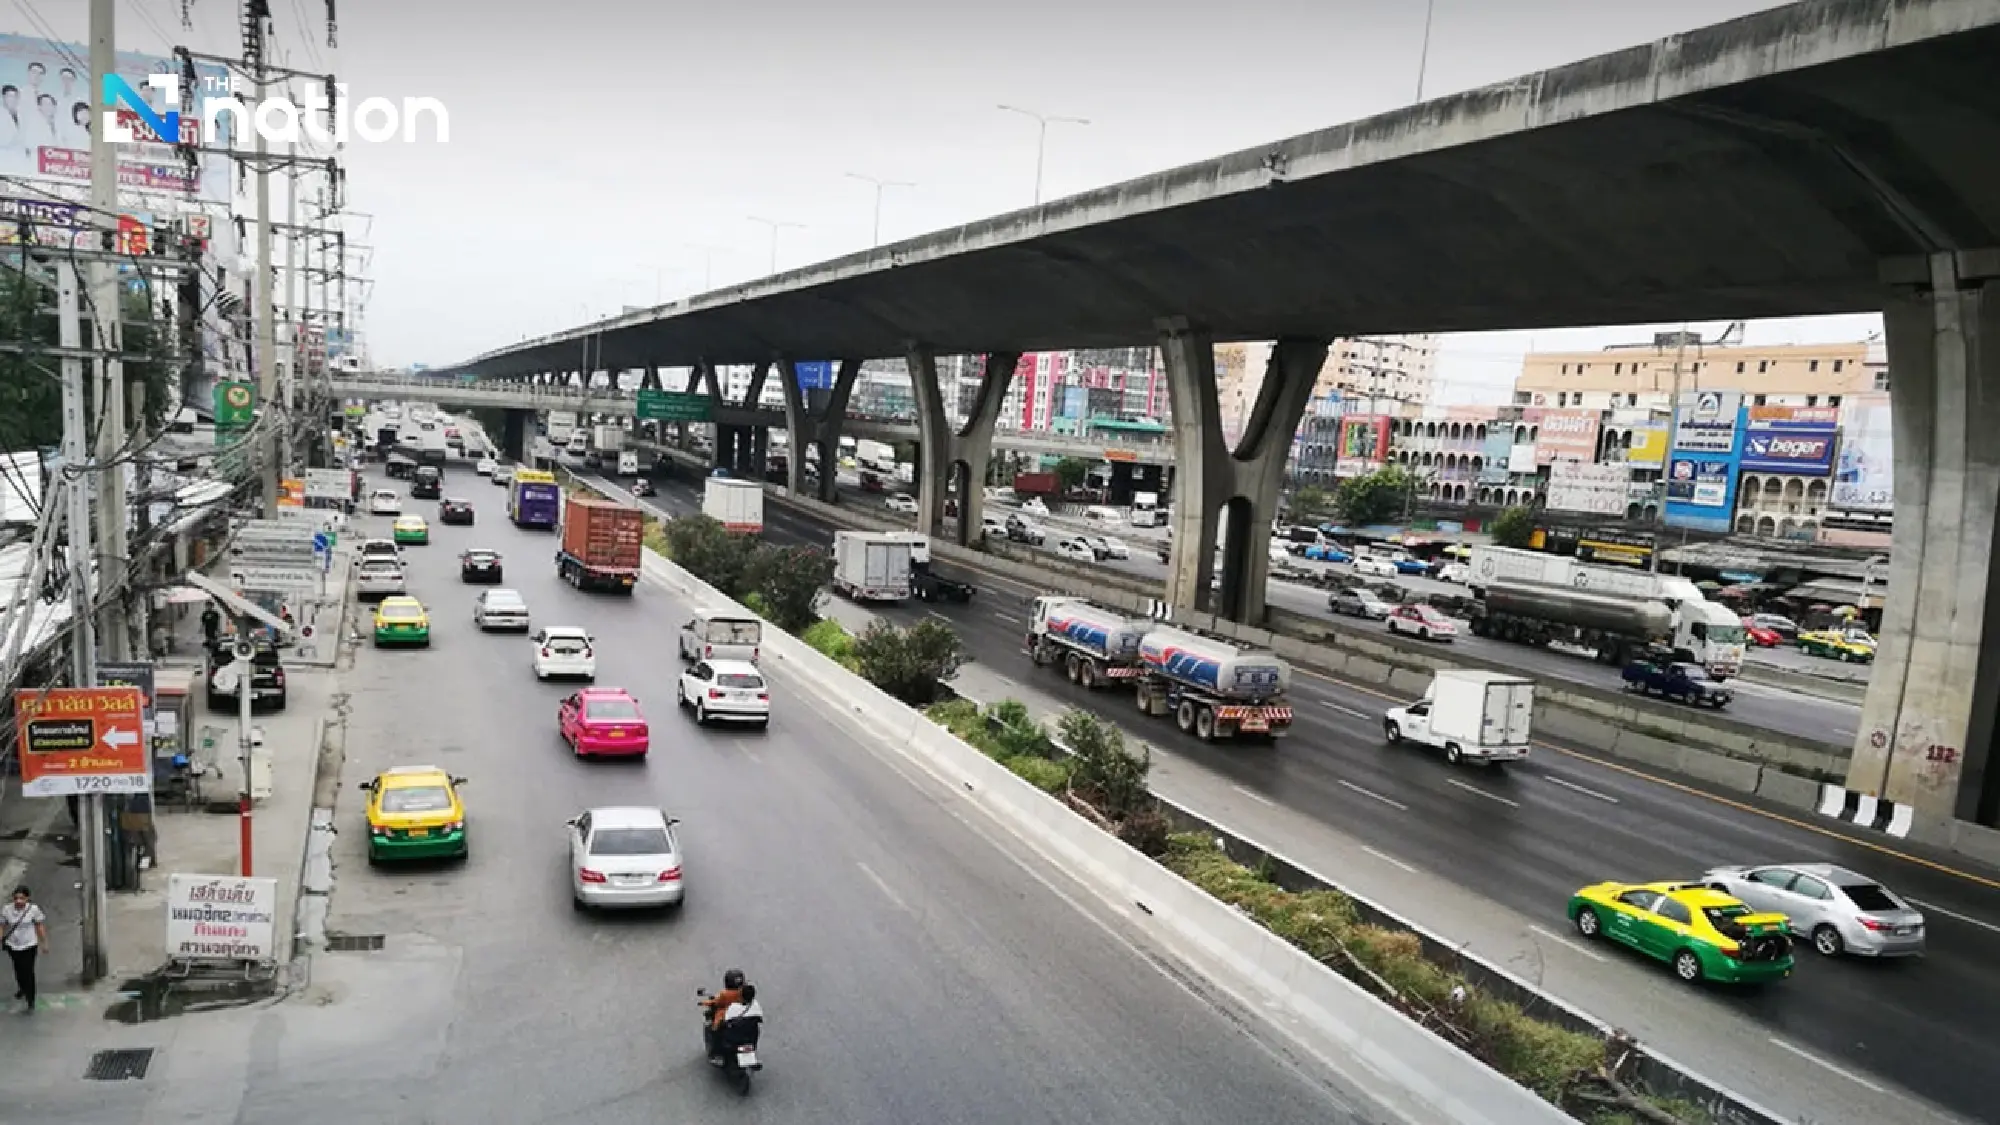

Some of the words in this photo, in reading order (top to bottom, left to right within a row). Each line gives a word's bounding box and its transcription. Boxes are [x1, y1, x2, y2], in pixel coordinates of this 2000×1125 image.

[1768, 435, 1824, 457] beger
[74, 776, 112, 790] 1720
[128, 776, 144, 787] 18
